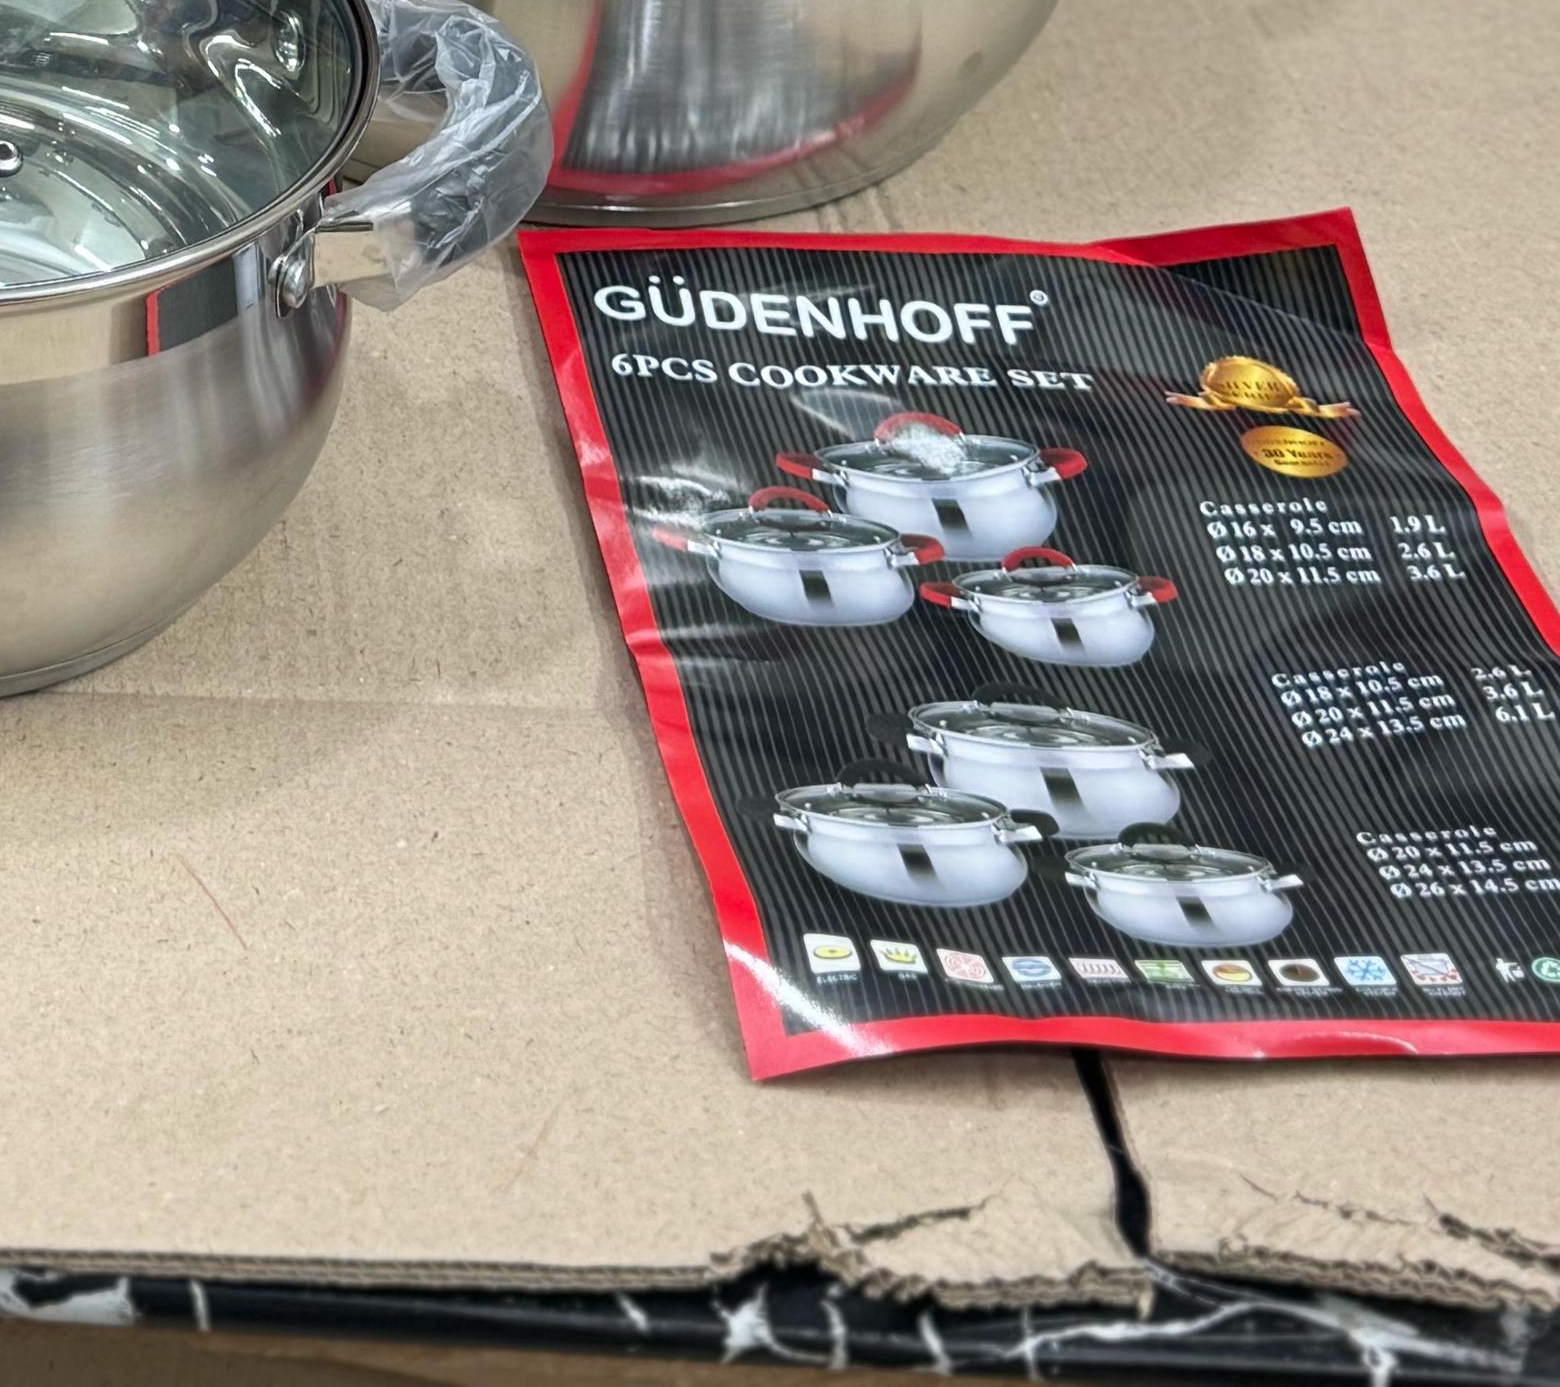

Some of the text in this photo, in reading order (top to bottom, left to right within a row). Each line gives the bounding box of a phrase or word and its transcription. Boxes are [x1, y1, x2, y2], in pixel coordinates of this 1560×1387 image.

[610, 353, 1094, 391] 6PCS COOKWARE SET
[1199, 497, 1328, 517] Casserole
[1230, 522, 1257, 537] 16
[1260, 523, 1277, 537] x
[1290, 519, 1323, 535] 9.5
[1328, 520, 1363, 535] cm
[1390, 516, 1421, 534] 1.9
[1424, 514, 1446, 534] L
[1240, 545, 1265, 562] 18
[1270, 547, 1285, 562] x
[1289, 543, 1332, 560] 10.5
[1337, 546, 1373, 561] cm
[1397, 543, 1431, 559] 2.6
[1433, 542, 1455, 559] L
[1247, 568, 1274, 584] 20
[1277, 570, 1293, 585] x
[1296, 567, 1341, 584] 11.5
[1345, 569, 1382, 583] cm
[1406, 565, 1441, 580] 3.6
[1442, 564, 1466, 580] L
[1271, 661, 1405, 688] Casserole
[1305, 687, 1333, 703] 18
[1337, 686, 1353, 699] x
[1356, 678, 1402, 695] 10.5
[1407, 674, 1444, 688] cm
[1471, 667, 1506, 681] 2.6
[1507, 664, 1532, 677] L
[1316, 707, 1343, 724] 20
[1347, 707, 1364, 720] x
[1367, 698, 1413, 715] 11.5
[1418, 693, 1455, 708] cm
[1482, 684, 1518, 701] 3.6
[1520, 681, 1544, 698] L
[1326, 728, 1354, 744] 24
[1357, 727, 1374, 740] x
[1377, 717, 1424, 736] 13.5
[1429, 714, 1467, 729] cm
[1495, 705, 1530, 723] 6.1
[1531, 702, 1555, 721] L
[1356, 825, 1496, 845] Casserole
[1392, 846, 1420, 860] 20
[1425, 847, 1443, 857] x
[1445, 841, 1494, 856] 11.5
[1500, 841, 1538, 852] cm
[1403, 863, 1434, 878] 24
[1438, 865, 1455, 877] x
[1458, 859, 1507, 874] 13.5
[1513, 859, 1551, 871] cm
[1415, 882, 1445, 897] 26
[1448, 884, 1467, 896] x
[1469, 878, 1519, 895] 14.5
[1525, 878, 1560, 892] cm
